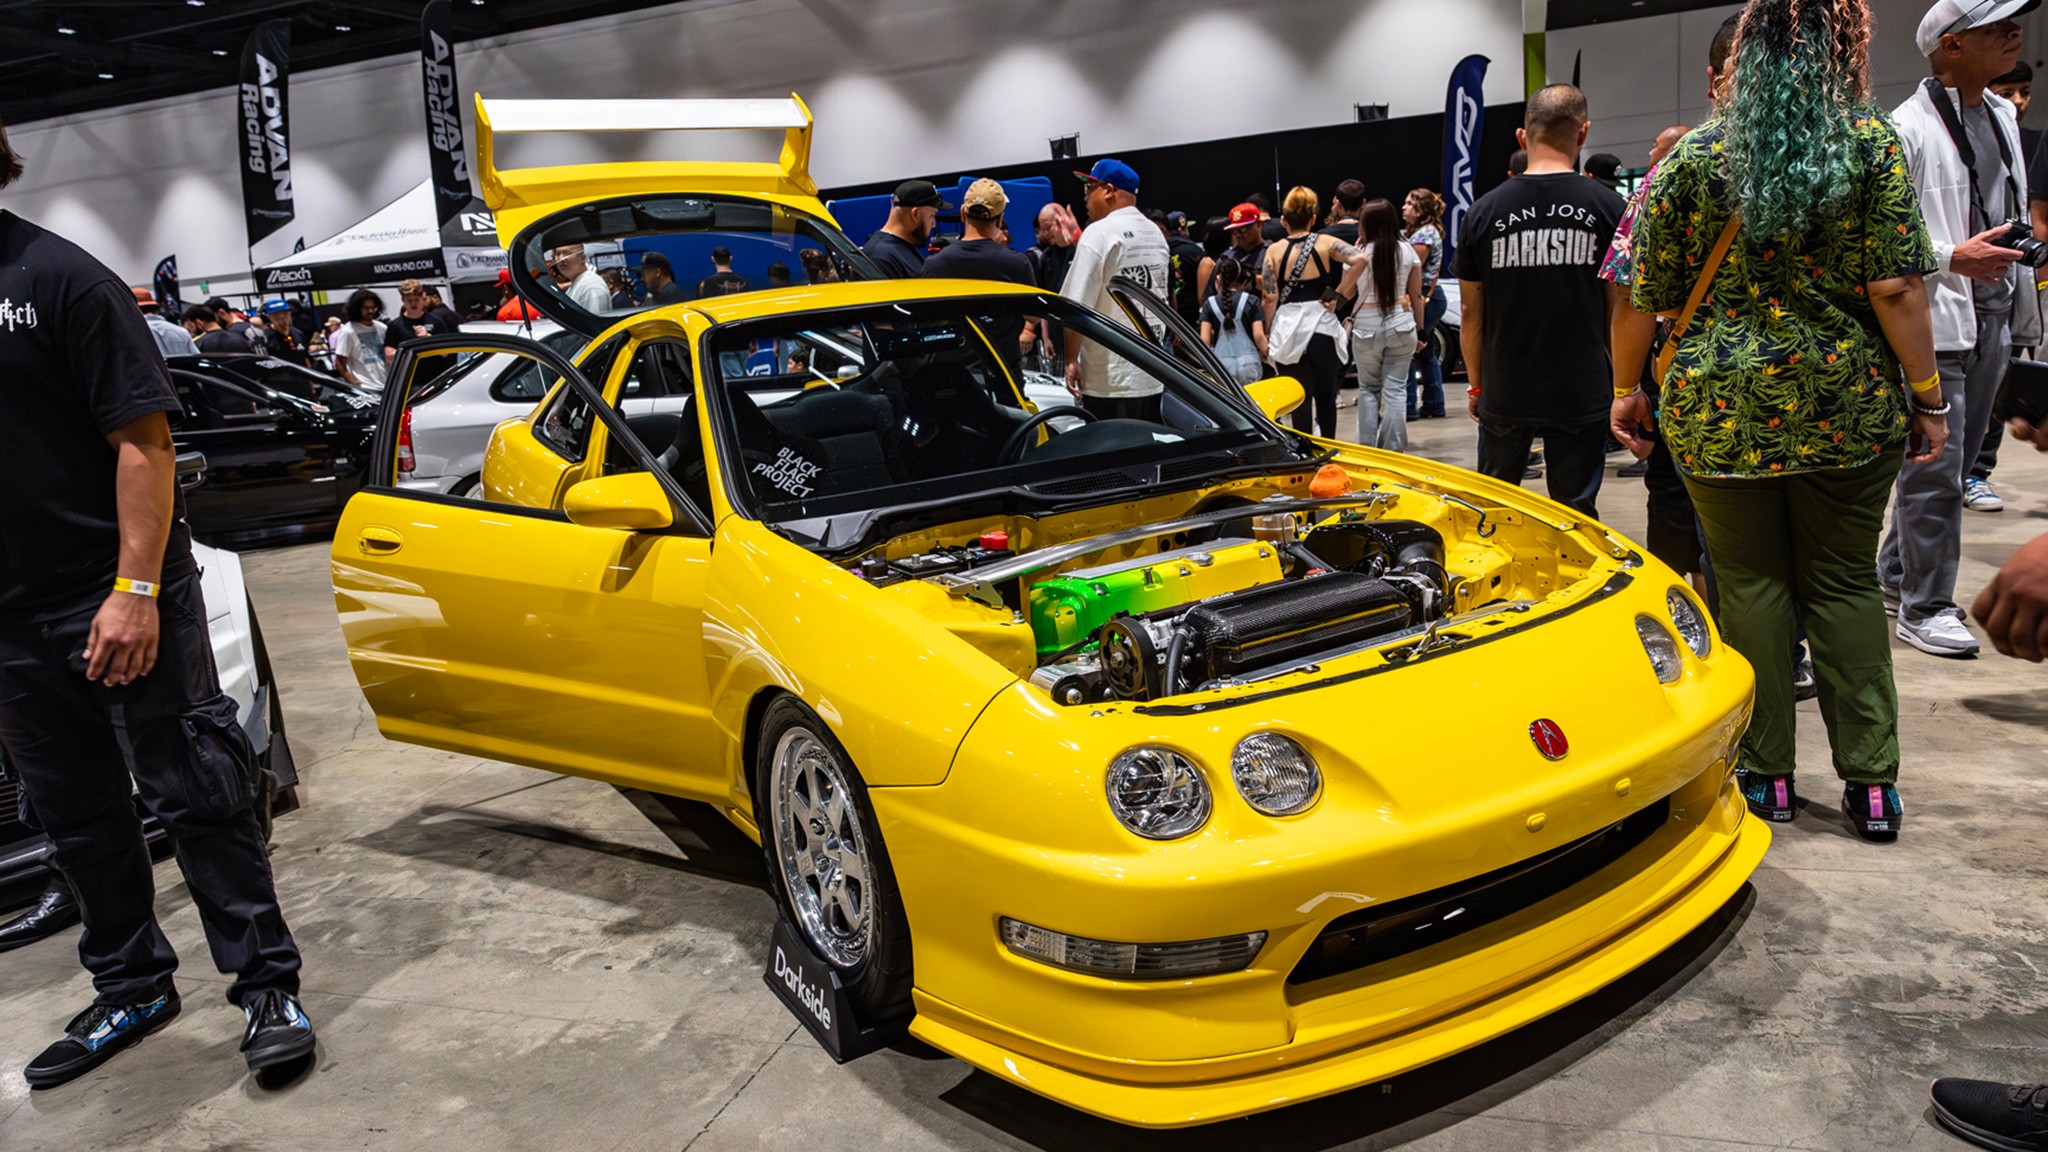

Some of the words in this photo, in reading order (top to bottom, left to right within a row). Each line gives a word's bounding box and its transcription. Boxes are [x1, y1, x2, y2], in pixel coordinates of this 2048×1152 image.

[242, 83, 266, 174] Racing
[256, 53, 293, 201] ADVAN
[425, 56, 450, 152] Racing
[430, 29, 468, 181] ADVAN
[1491, 227, 1598, 269] DARKSIDE
[1495, 206, 1536, 232] SAN
[1546, 204, 1597, 228] JOSE
[751, 463, 815, 498] PROJECT
[773, 458, 809, 485] FLAG
[776, 446, 823, 479] BLACK
[774, 945, 832, 1030] Darkside
